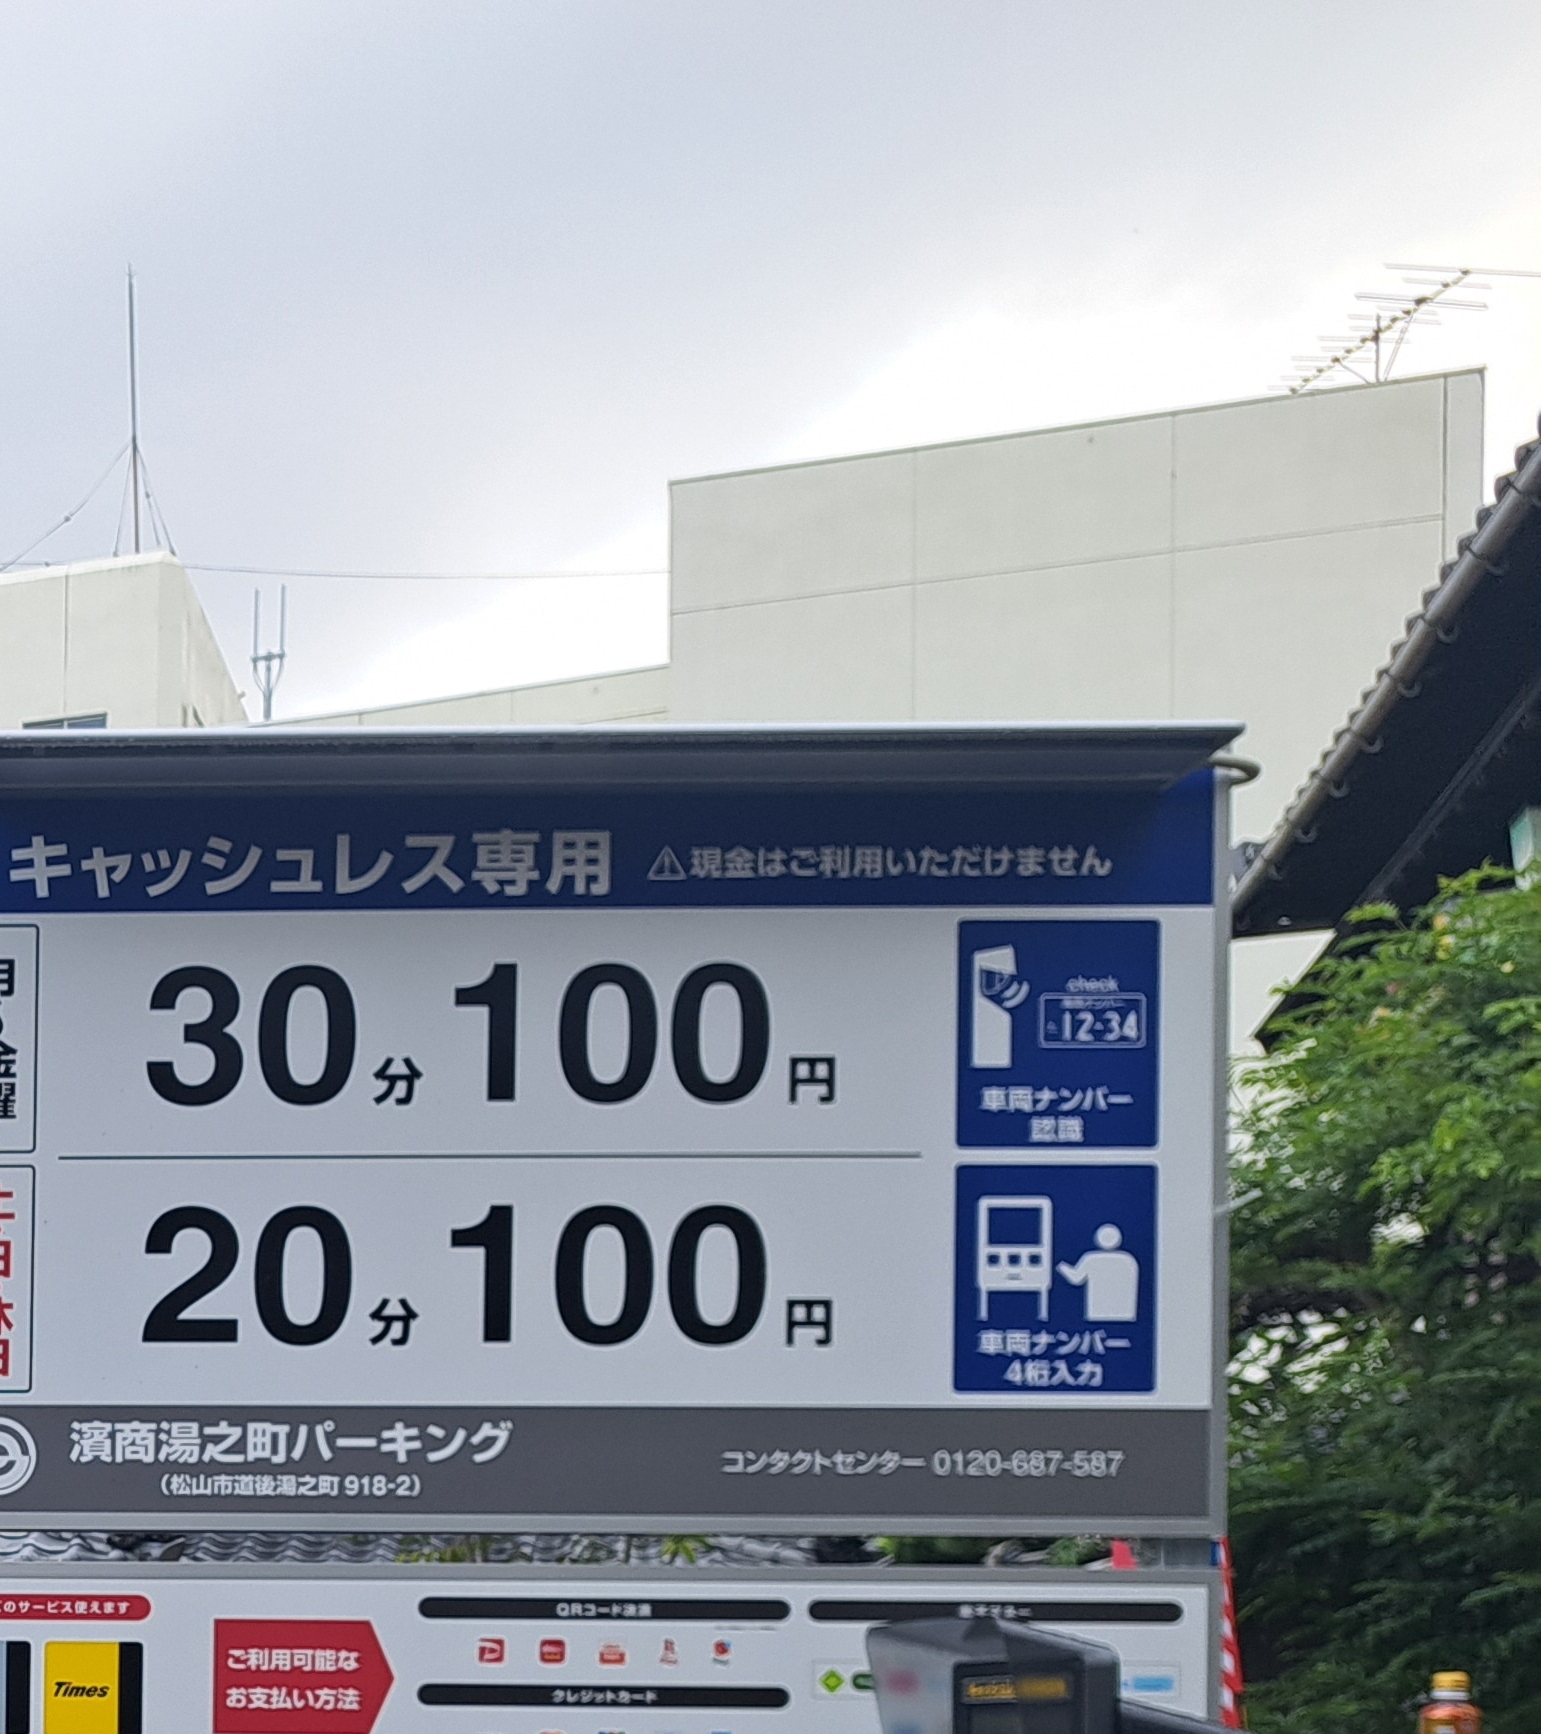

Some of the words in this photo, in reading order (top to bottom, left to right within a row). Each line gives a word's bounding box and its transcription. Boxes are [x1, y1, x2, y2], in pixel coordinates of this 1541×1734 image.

[9, 829, 613, 899] キャッシュレス専用
[690, 845, 1113, 880] 現金はご利用いただけません
[146, 964, 424, 1107] 30分
[454, 961, 837, 1105] 100円
[980, 1084, 1134, 1114] 車両ナンバー
[142, 1205, 420, 1347] 20分
[450, 1204, 833, 1347] 100円
[976, 1328, 1132, 1357] 車両ナンバー
[1003, 1358, 1104, 1388] 4桁入力
[69, 1419, 514, 1464] 濱商湯之町パーキング
[721, 1449, 927, 1476] コンタクトセンター
[226, 1647, 363, 1672] ご利用可能な
[53, 1681, 110, 1698] Times
[225, 1686, 363, 1711] お支払い方法
[550, 1689, 658, 1705] クレジットカード
